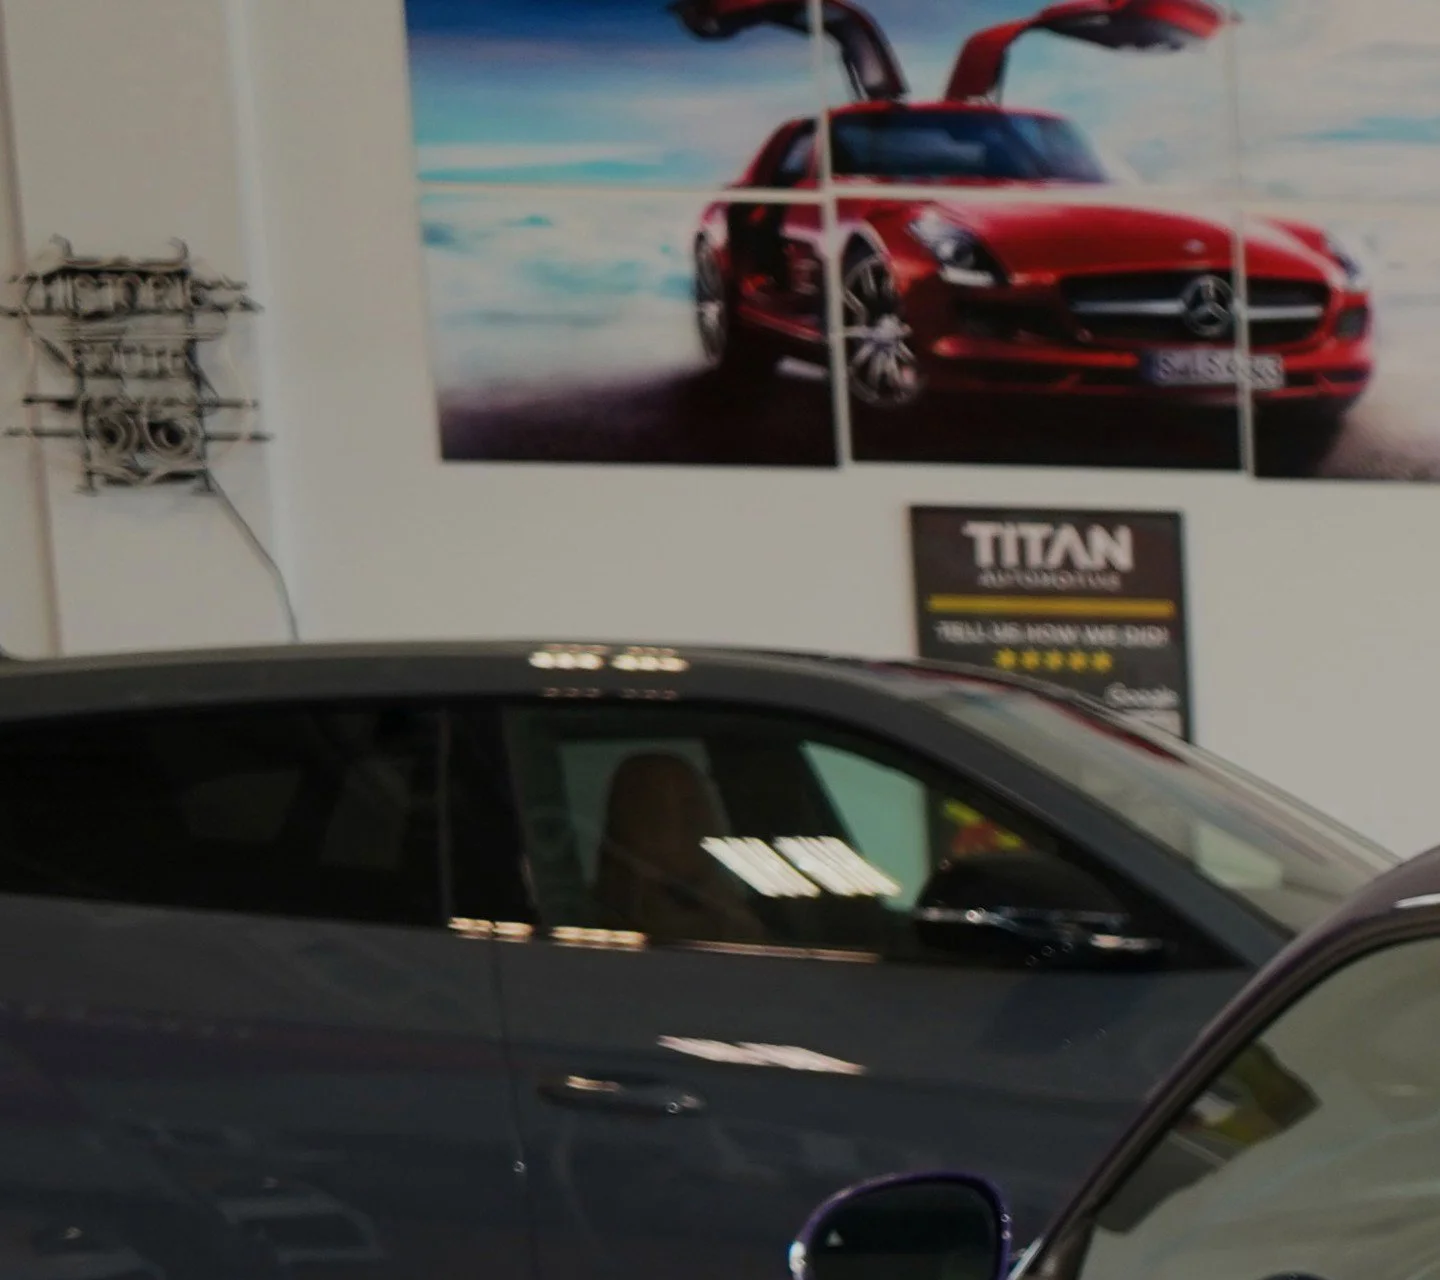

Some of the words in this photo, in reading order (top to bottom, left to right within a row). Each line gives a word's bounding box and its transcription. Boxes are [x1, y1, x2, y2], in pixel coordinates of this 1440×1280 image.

[961, 520, 1135, 573] TITAN
[935, 620, 987, 644] TELL
[990, 621, 1022, 644] US
[1026, 624, 1079, 646] HOW
[1083, 624, 1120, 646] WE
